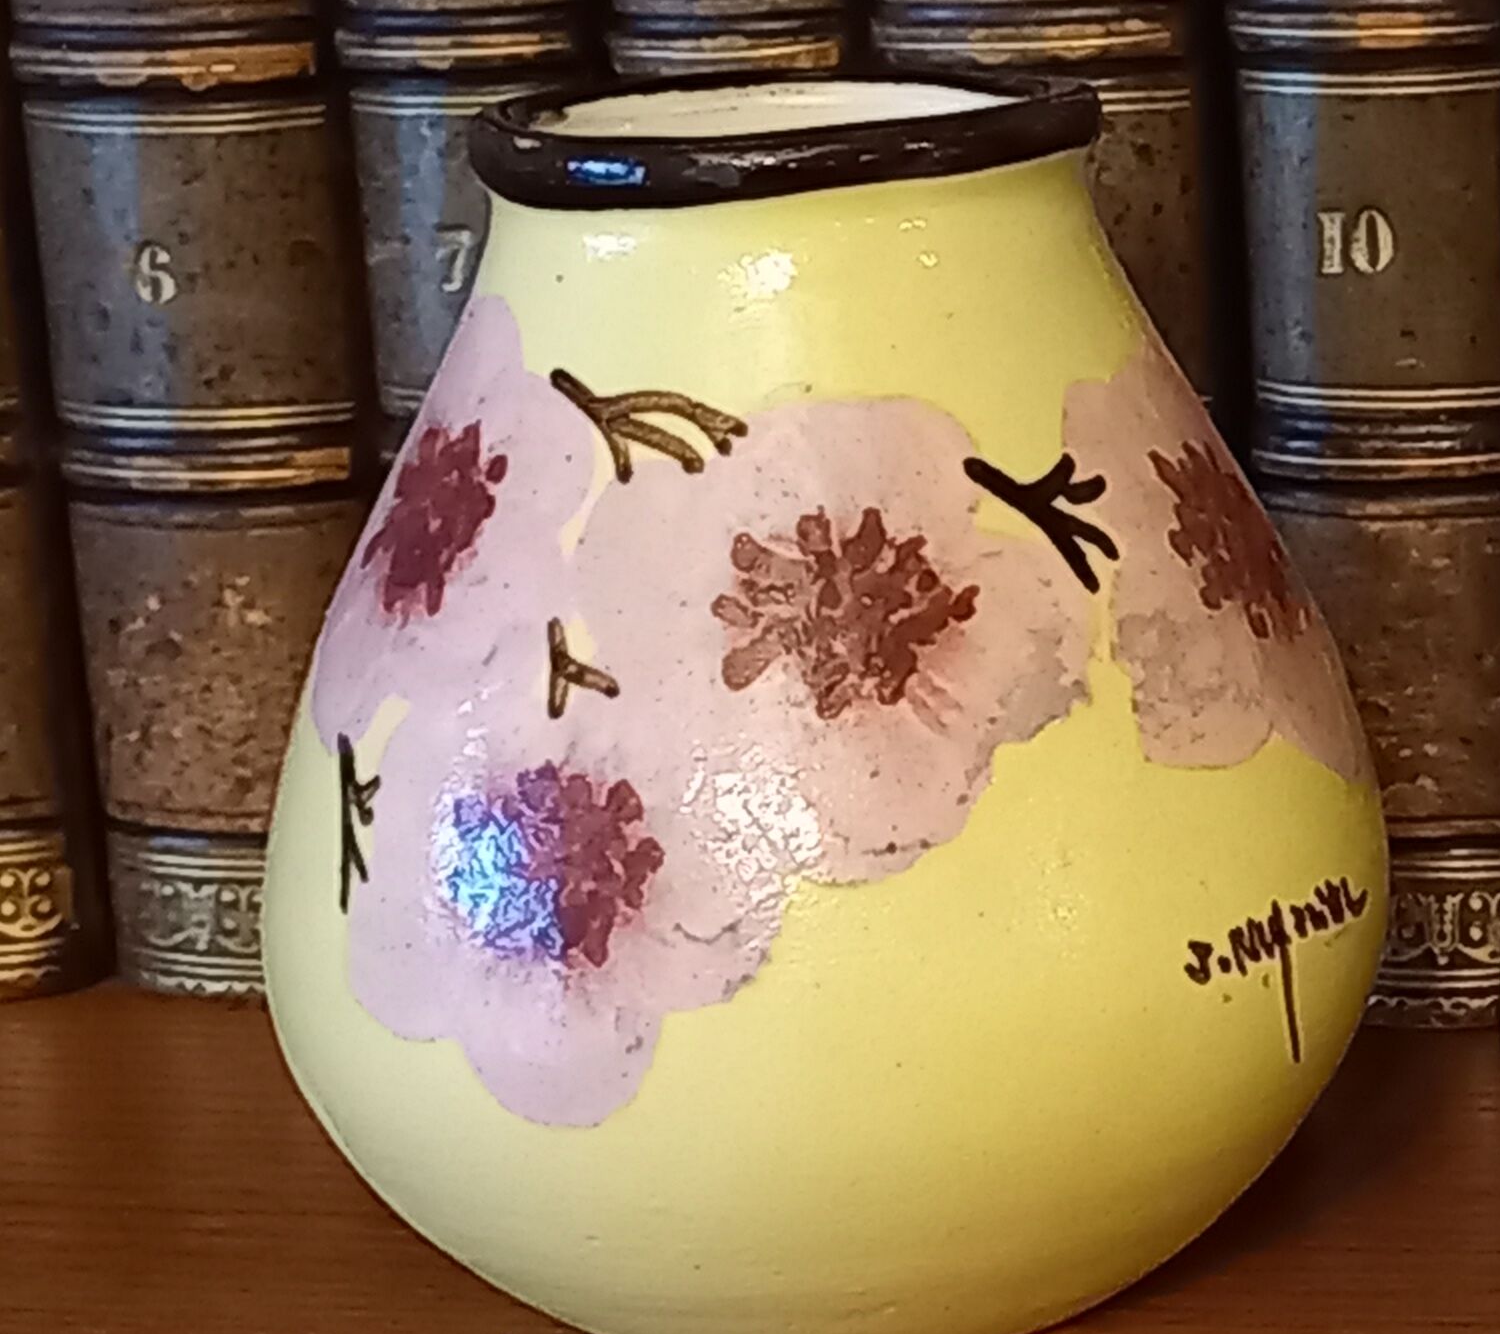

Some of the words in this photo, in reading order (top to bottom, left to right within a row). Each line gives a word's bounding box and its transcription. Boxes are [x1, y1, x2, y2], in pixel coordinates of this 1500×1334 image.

[438, 227, 473, 292] 7
[1317, 209, 1394, 275] 10
[135, 246, 178, 305] 6
